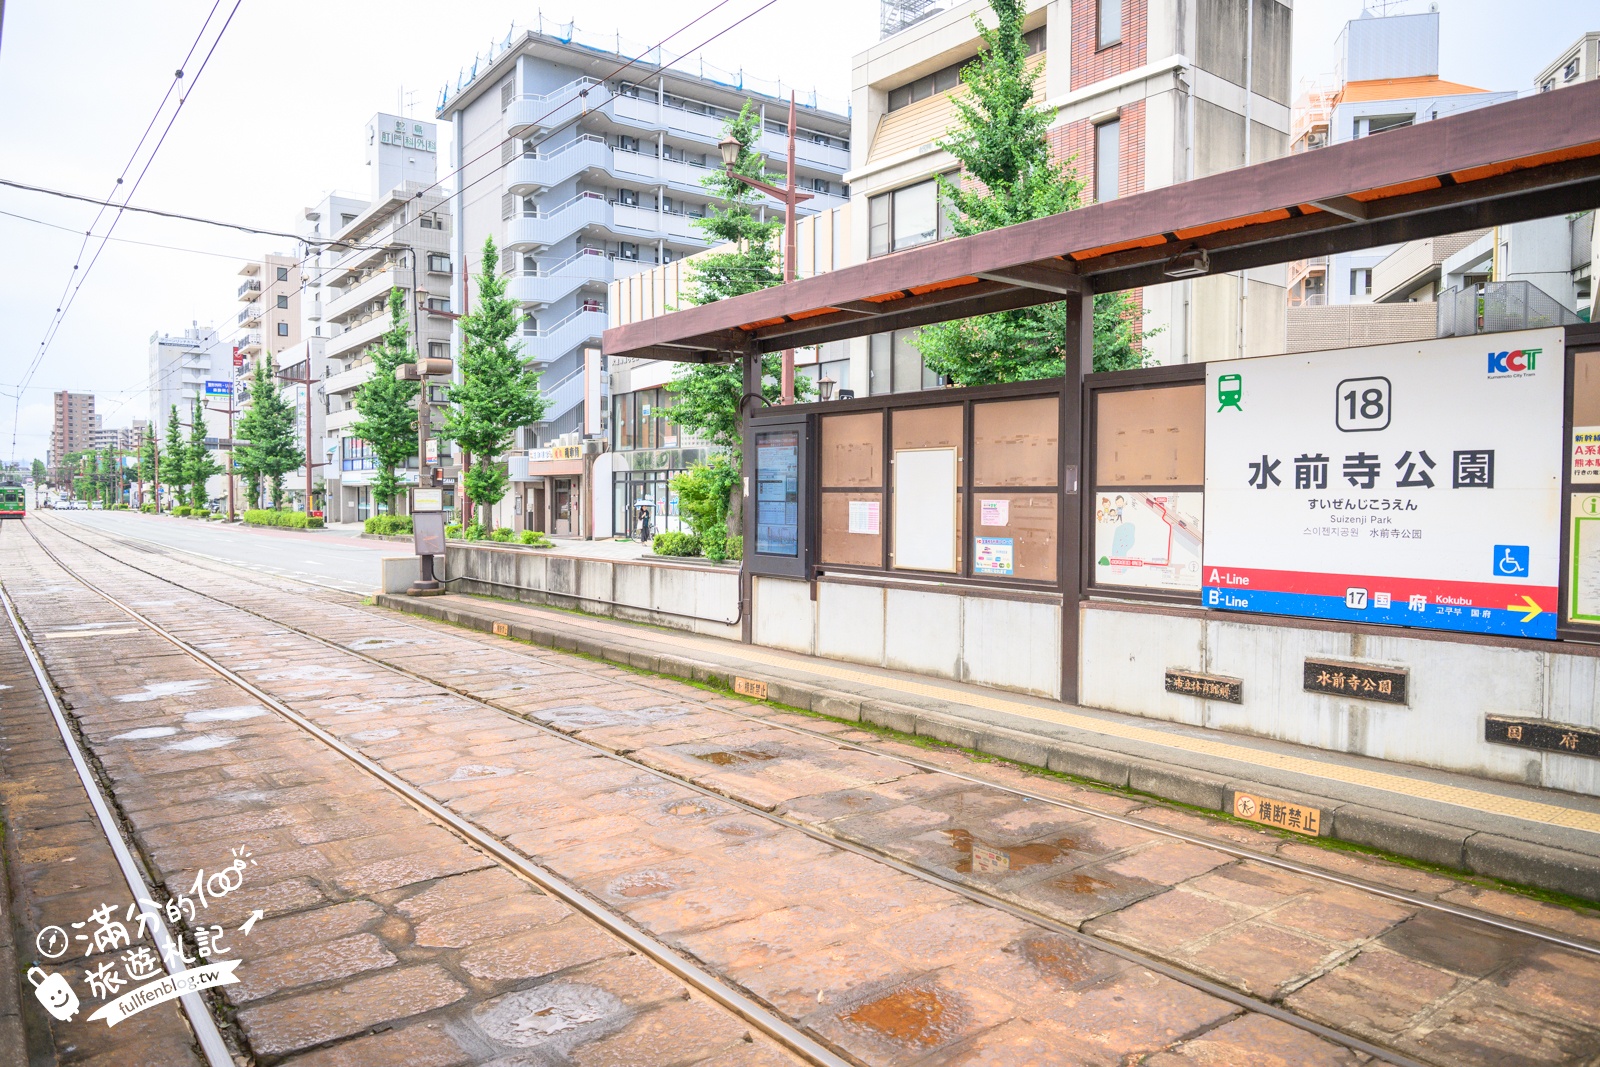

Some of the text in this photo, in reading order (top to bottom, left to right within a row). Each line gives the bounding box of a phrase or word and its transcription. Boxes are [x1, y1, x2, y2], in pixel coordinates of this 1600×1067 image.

[1487, 348, 1543, 373] KCT
[1343, 388, 1384, 420] 18
[1574, 445, 1600, 456] A系
[1248, 449, 1496, 491] 水前寺公園
[1307, 498, 1418, 512] すいぜんじこうえん
[1330, 514, 1392, 525] Suizenji Park
[1209, 568, 1250, 586] A-Line
[1208, 590, 1249, 609] B-Line
[1348, 591, 1427, 612] 17 国府
[1435, 595, 1472, 606] Kokubu
[1435, 606, 1462, 617] 고쿠부
[1316, 669, 1393, 697] 水前寺公園
[1258, 799, 1318, 834] 横断禁止
